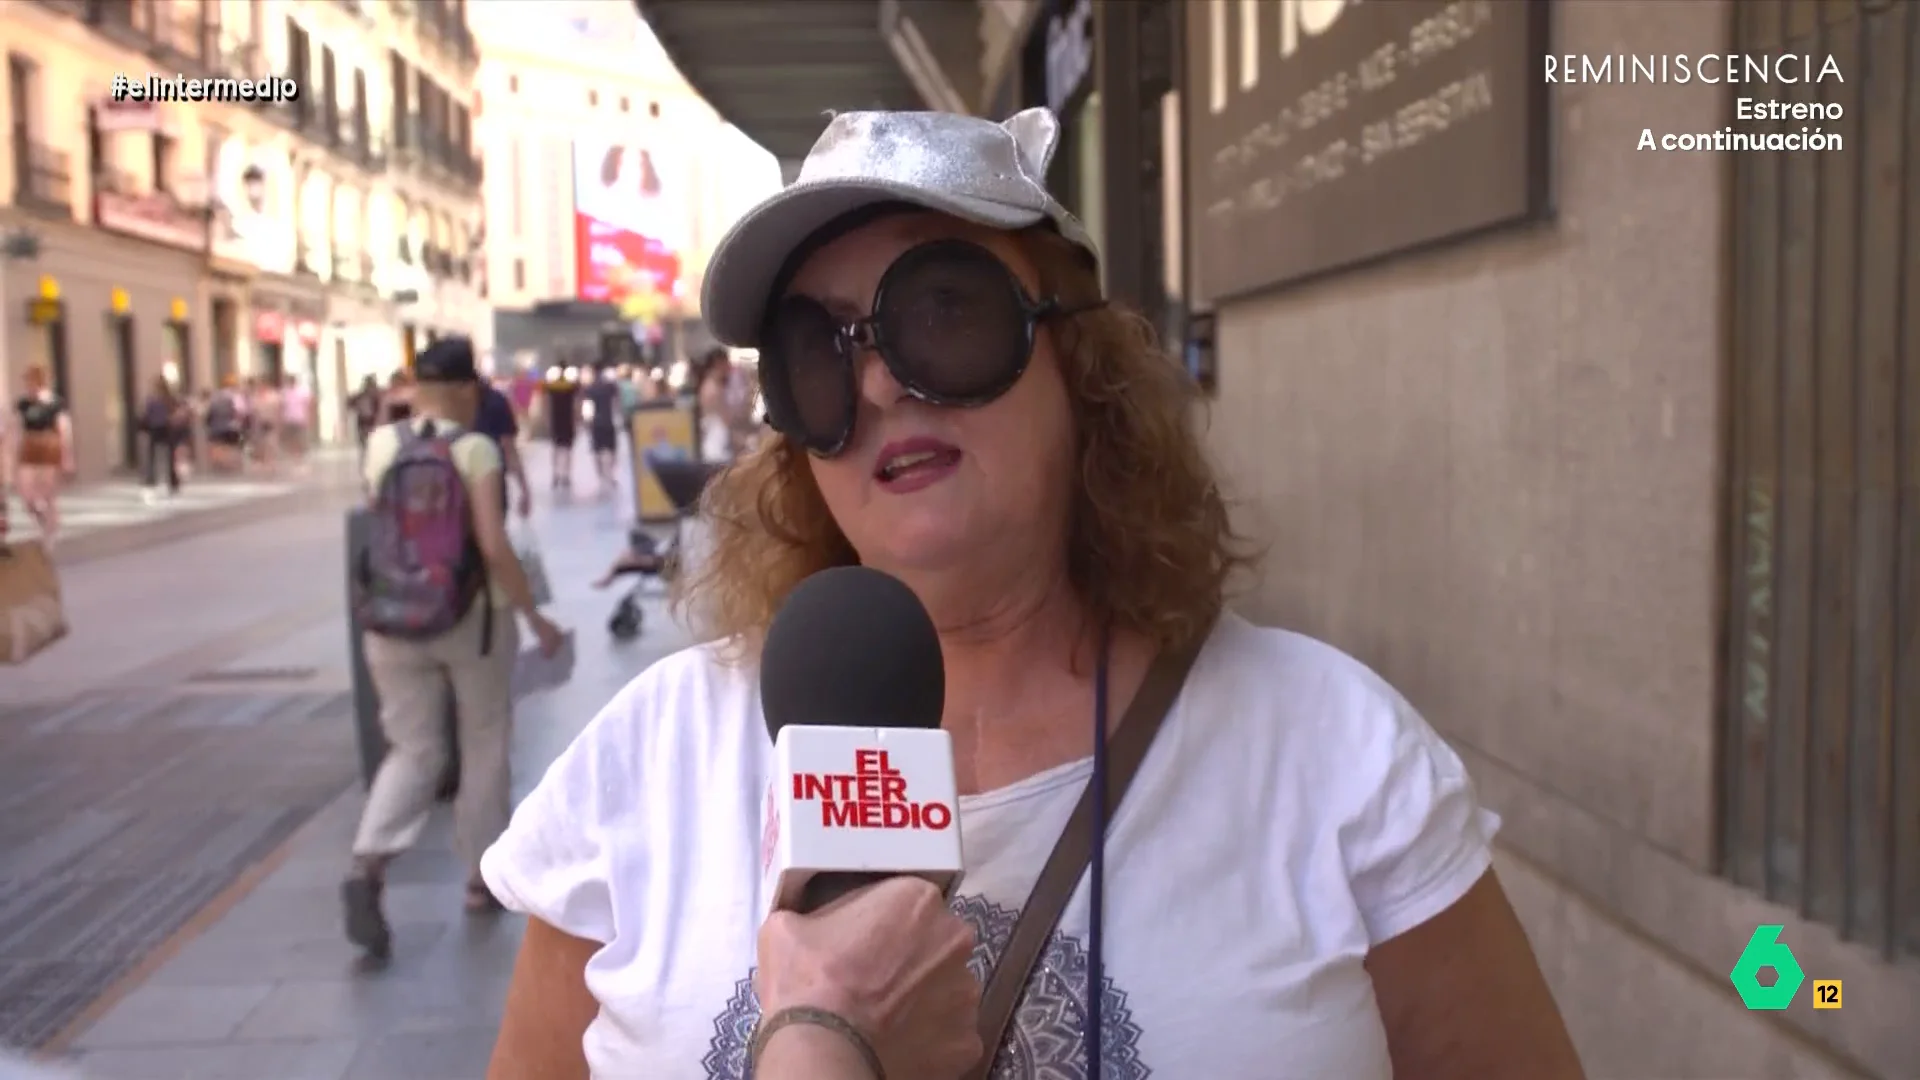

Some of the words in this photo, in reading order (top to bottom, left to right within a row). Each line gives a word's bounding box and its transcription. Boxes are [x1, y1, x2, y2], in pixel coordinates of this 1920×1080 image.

[855, 749, 900, 776] EL
[792, 773, 908, 802] INTER
[821, 800, 952, 830] MEDIO
